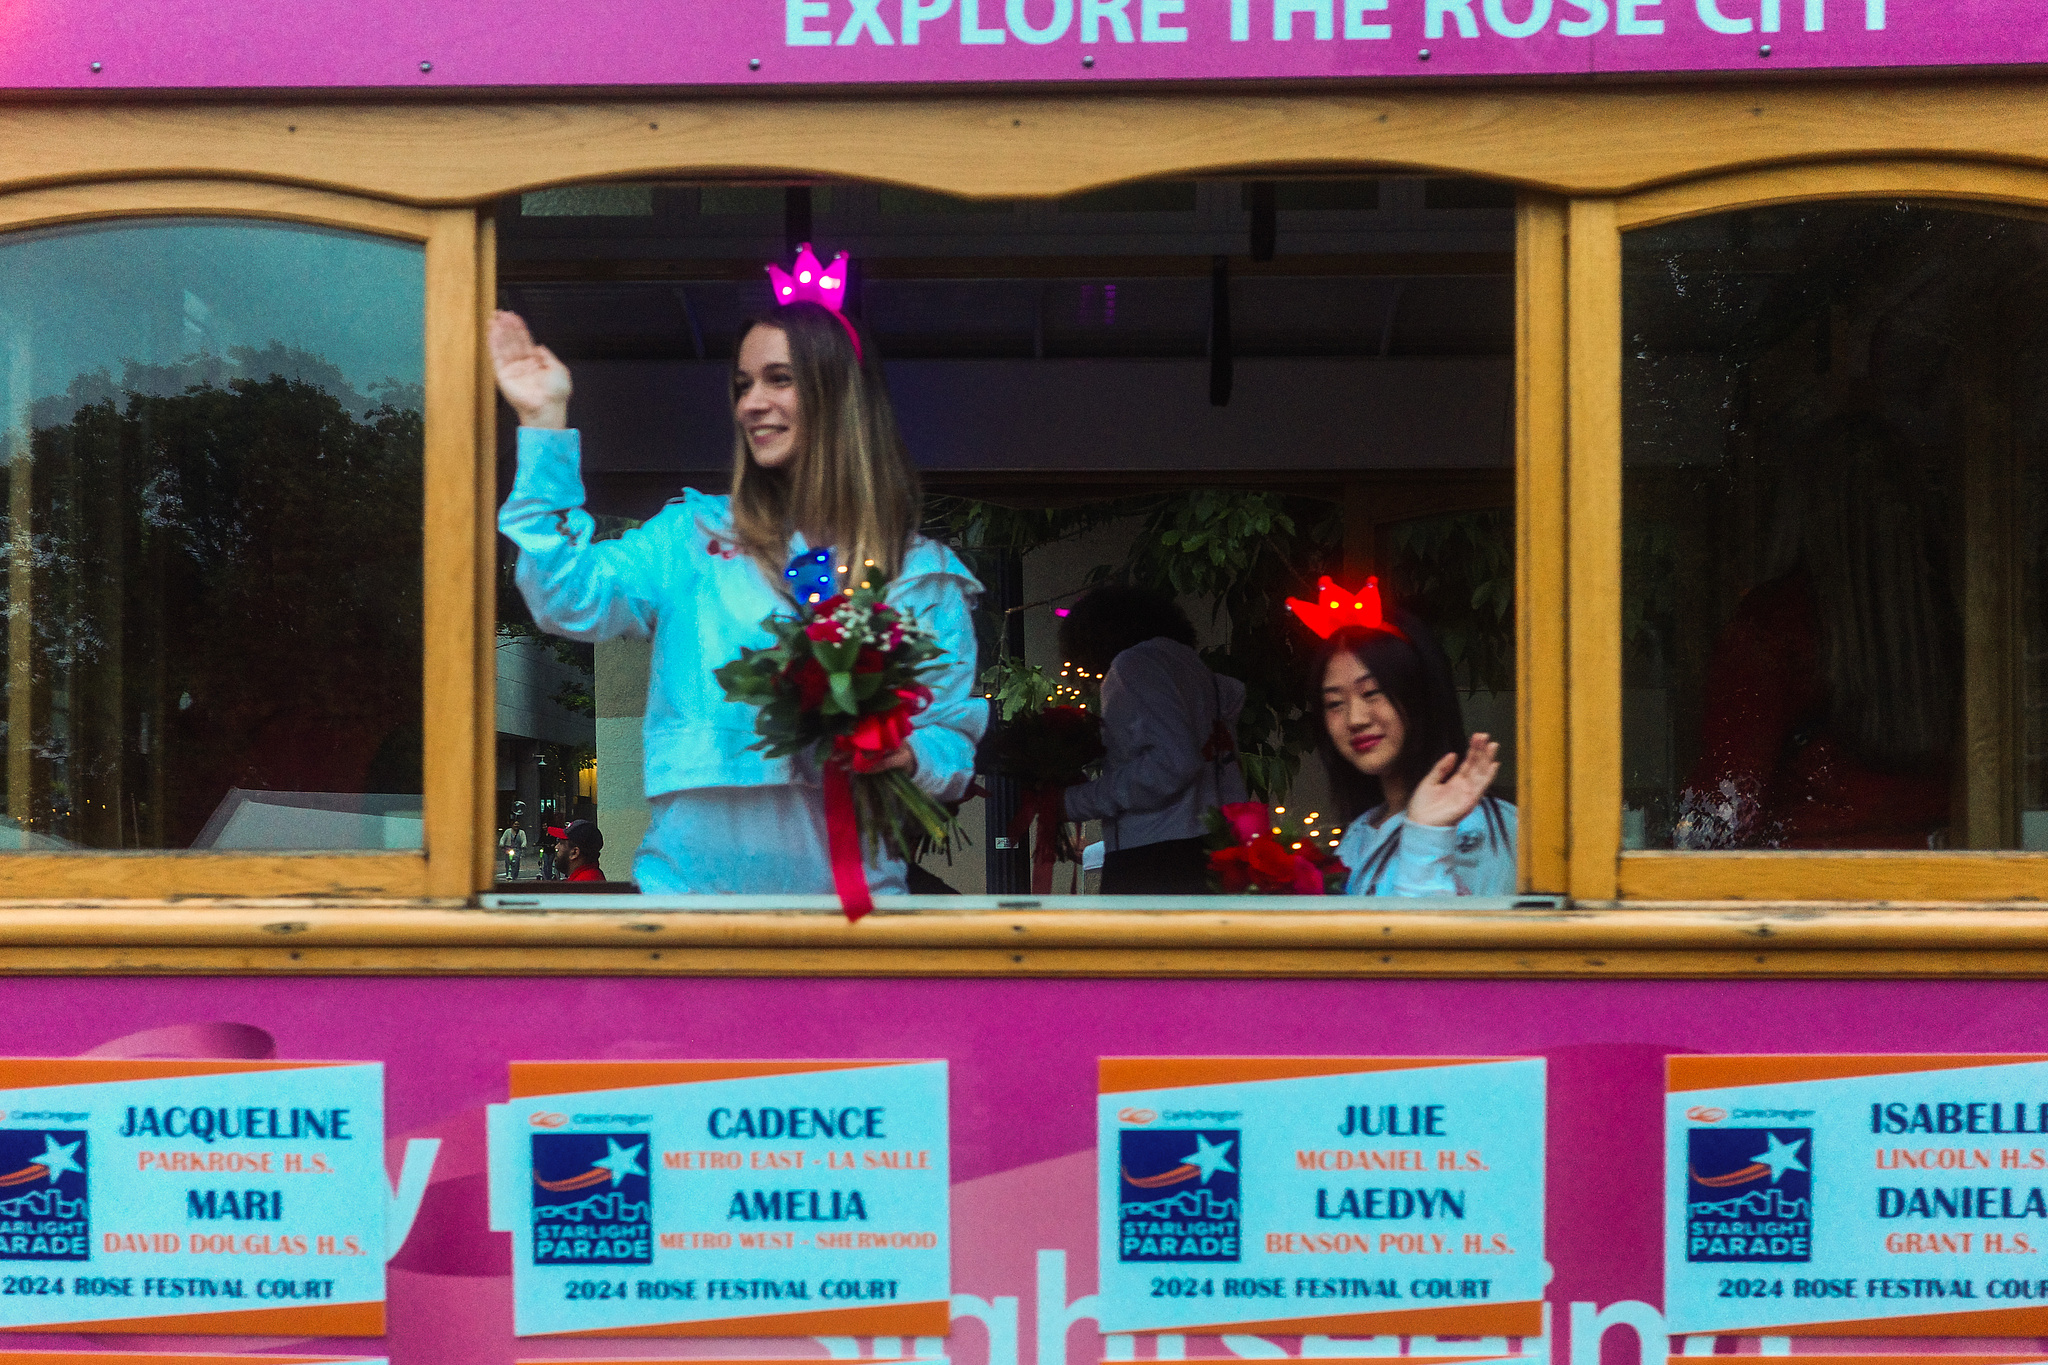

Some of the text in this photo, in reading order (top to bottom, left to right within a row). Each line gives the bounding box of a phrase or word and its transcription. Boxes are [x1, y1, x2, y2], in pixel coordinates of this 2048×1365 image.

[786, 0, 1187, 46] EXPLORE
[120, 1107, 351, 1142] JACQUELINE
[707, 1107, 886, 1139] CADENCE
[1338, 1104, 1446, 1137] JULIE
[138, 1151, 335, 1174] PARKROSE H.S.
[662, 1150, 743, 1170] METRO
[750, 1150, 805, 1170] EAST
[827, 1151, 856, 1170] LA
[863, 1150, 932, 1170] SALLE
[1296, 1149, 1490, 1171] MCDANIEL H.S.
[1875, 1148, 2048, 1170] LINCOLN H.S
[187, 1190, 282, 1221] MARI
[727, 1190, 868, 1222] AMELIA
[1316, 1188, 1465, 1220] LAEDYN
[1877, 1186, 2048, 1219] DANIELA
[537, 1224, 648, 1239] STARLIGHT
[1123, 1221, 1236, 1236] STARLIGHT
[1691, 1221, 1806, 1236] STARLIGHT
[103, 1232, 368, 1256] DAVID DOUGLAS H.S.
[537, 1240, 648, 1259] PARADE
[658, 1231, 733, 1250] METRO
[738, 1231, 795, 1250] WEST
[816, 1231, 938, 1250] SHERWOOD
[1123, 1237, 1237, 1256] PARADE
[1265, 1232, 1516, 1255] BENSON POLY. H.S.
[1690, 1237, 1807, 1256] PARADE
[1884, 1232, 2038, 1255] GRANT H.S.
[2, 1276, 334, 1299] 2024 ROSE FESTIVAL COURT
[565, 1280, 898, 1300] 2024 ROSE FESTIVAL COURT
[1150, 1278, 1492, 1299] 2024 ROSE FESTIVAL COURT
[1718, 1278, 1784, 1299] 2024
[1793, 1278, 1858, 1299] ROSE
[1866, 1278, 1978, 1299] FESTIVAL
